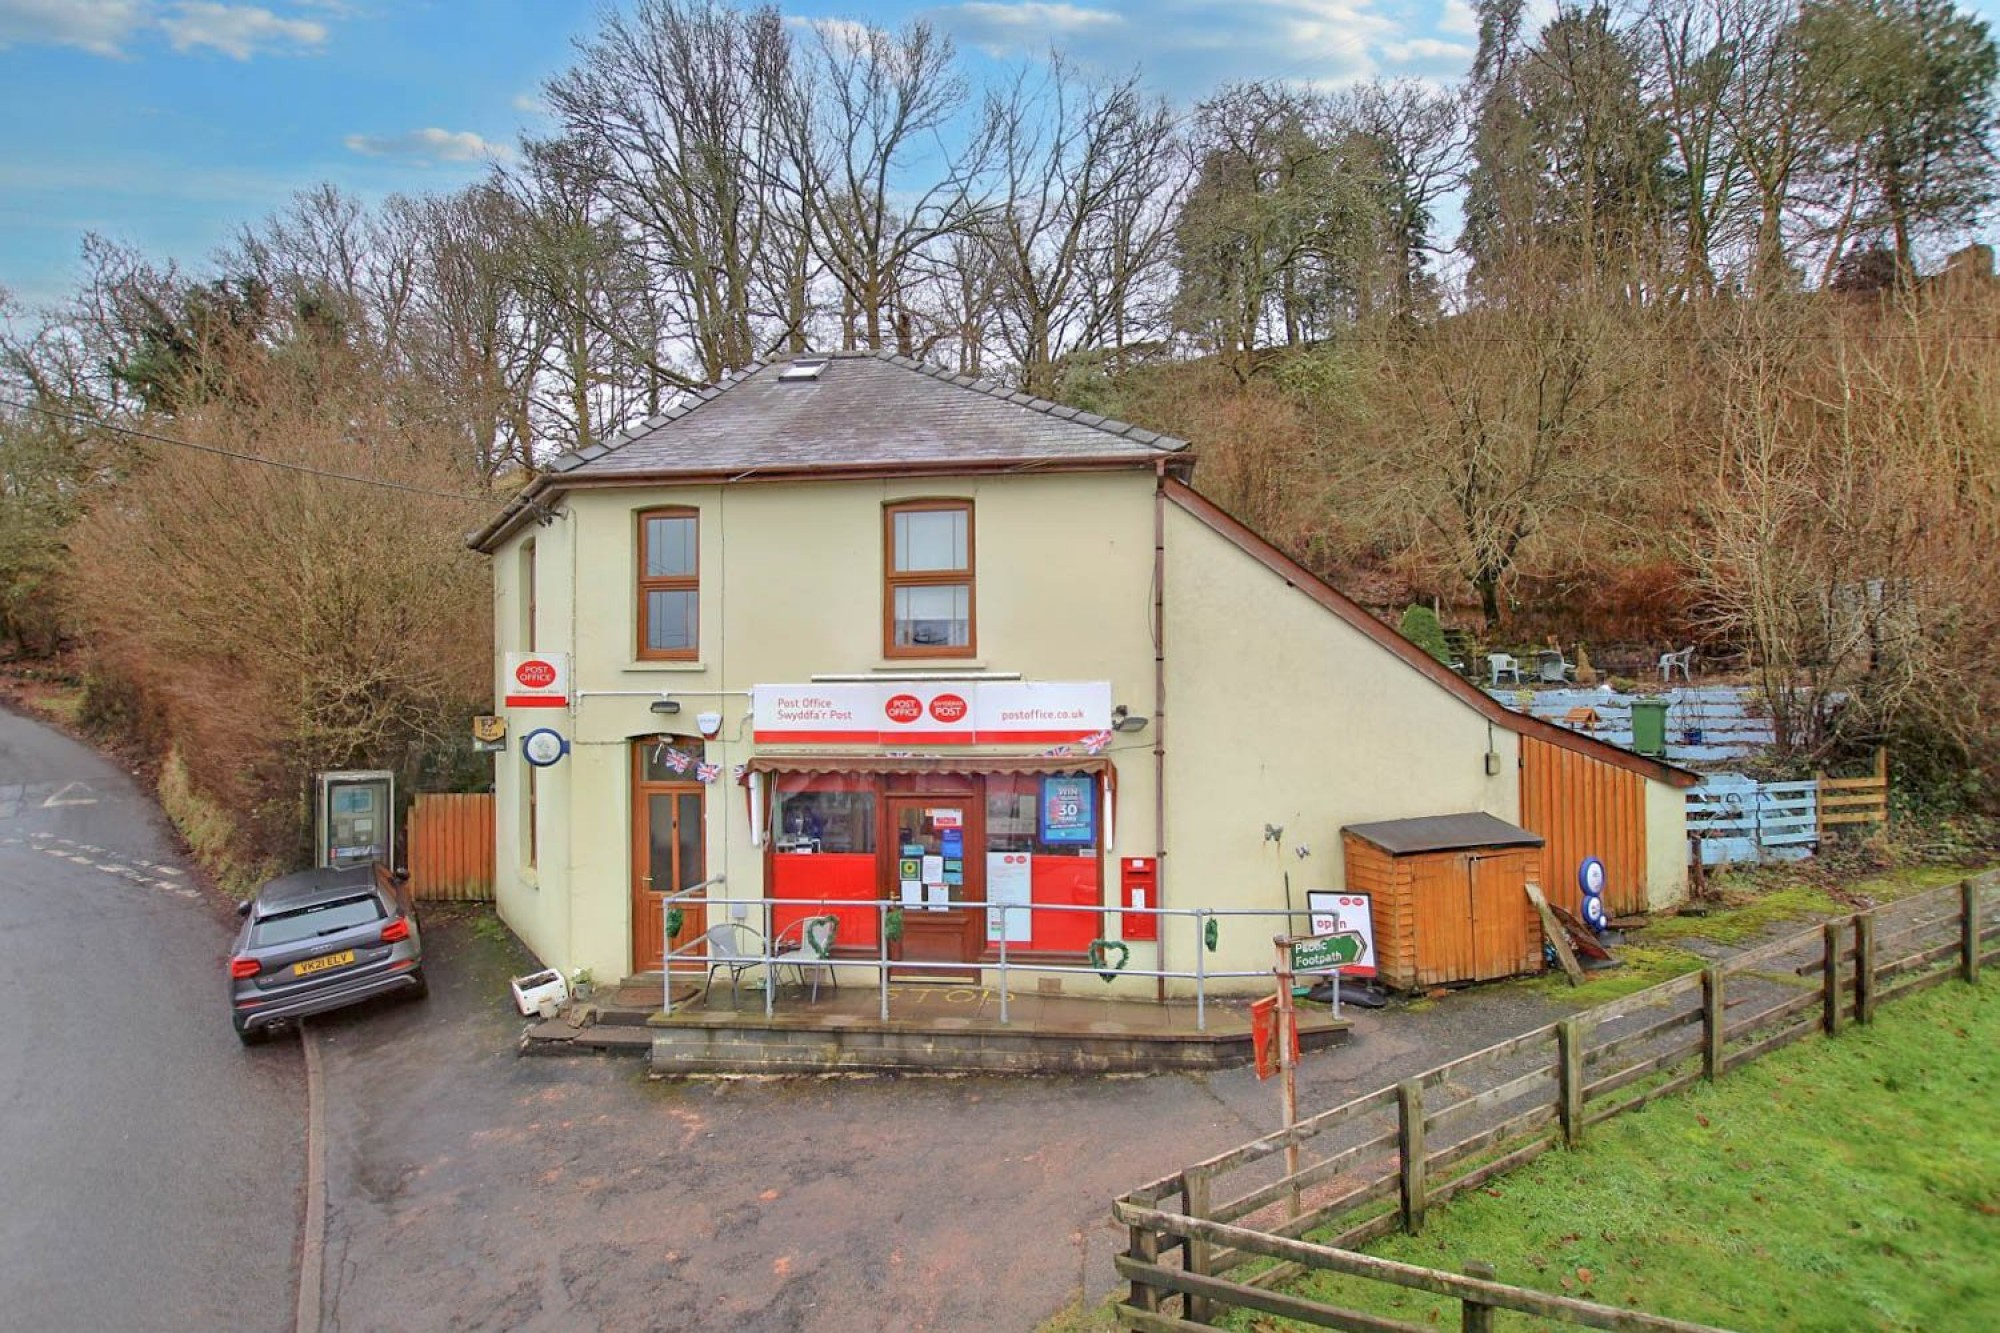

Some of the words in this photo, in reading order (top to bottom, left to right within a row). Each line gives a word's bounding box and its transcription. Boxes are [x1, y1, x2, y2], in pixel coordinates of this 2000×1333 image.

[524, 665, 549, 673] POST
[519, 672, 552, 681] OFFICE
[778, 697, 800, 708] Post
[802, 697, 832, 708] Office
[893, 700, 917, 708] POST
[778, 709, 827, 721] Swyddfa'r
[830, 709, 852, 719] Post
[888, 707, 918, 717] OFFICE
[935, 707, 961, 717] POST
[1002, 709, 1084, 721] postoffice.co.uk
[1058, 787, 1078, 797] WIN
[1316, 919, 1347, 930] opn
[1295, 951, 1342, 967] Footpath
